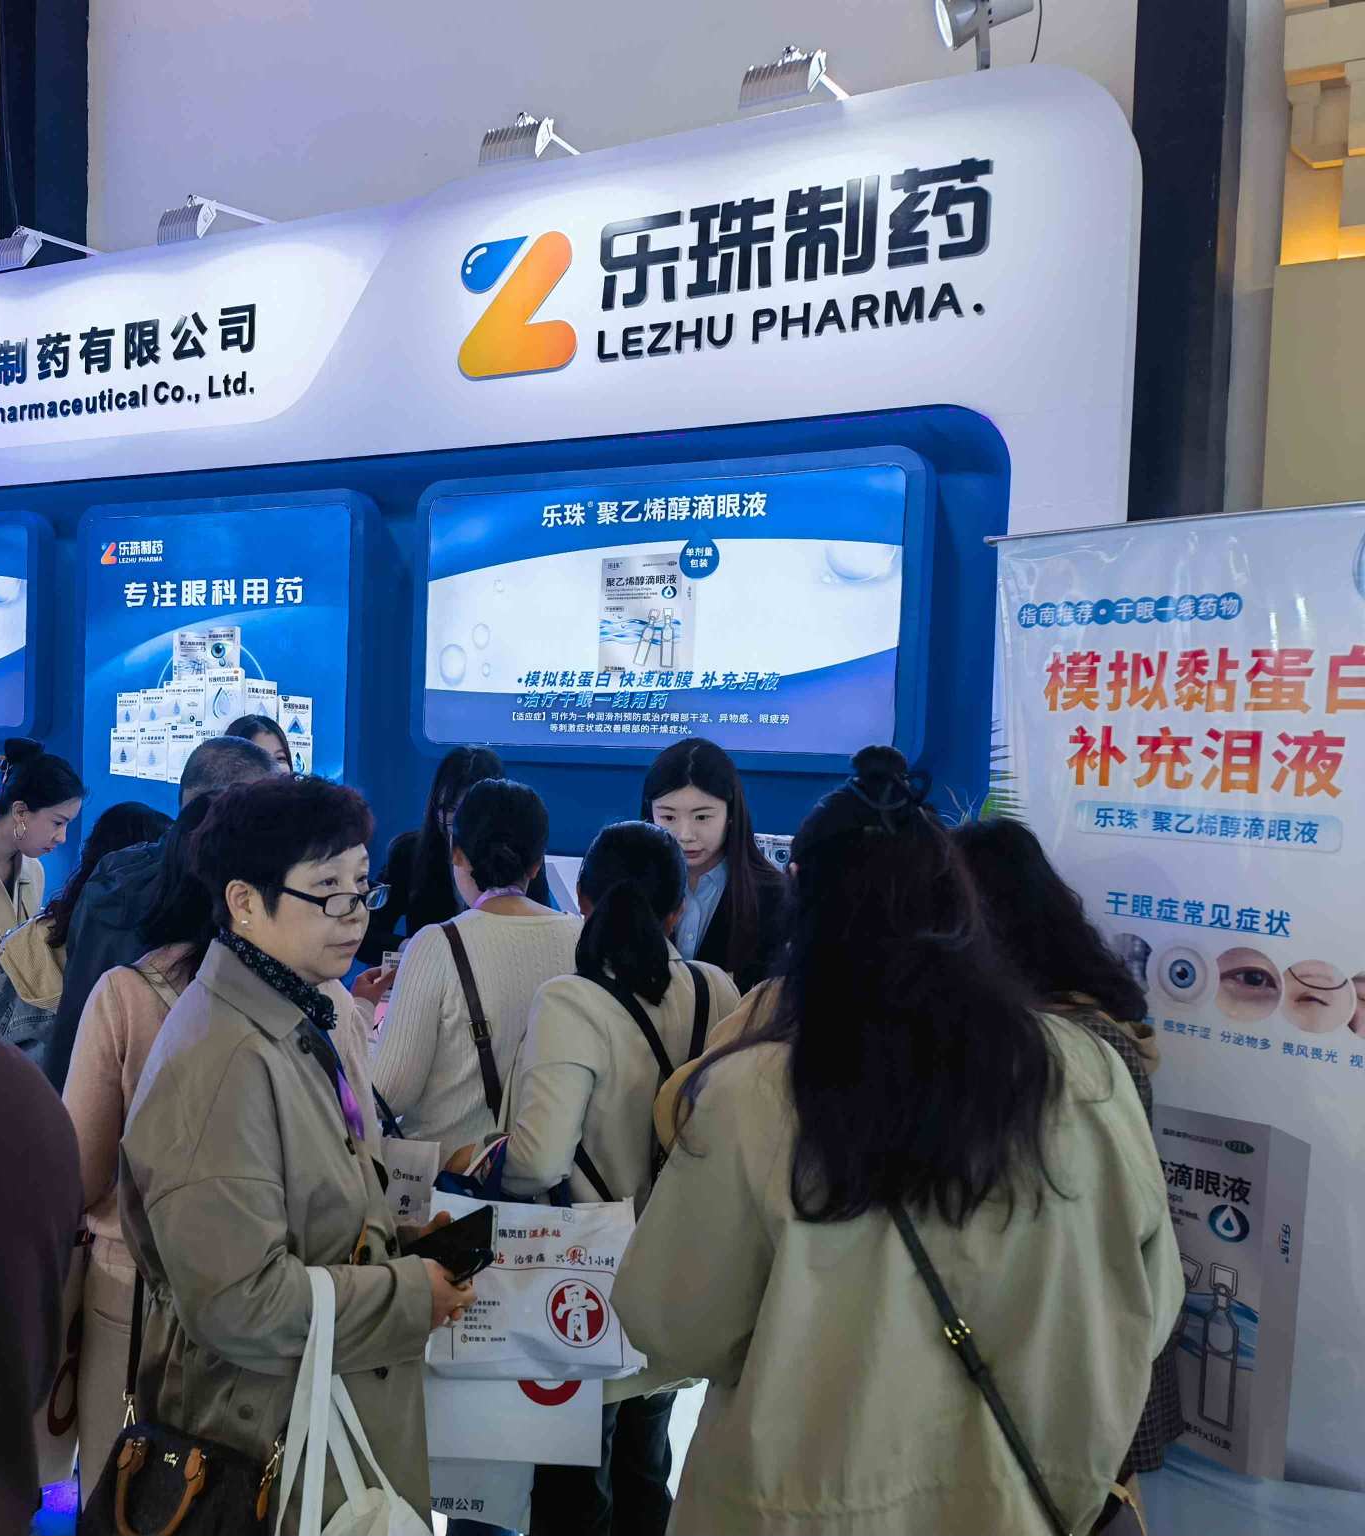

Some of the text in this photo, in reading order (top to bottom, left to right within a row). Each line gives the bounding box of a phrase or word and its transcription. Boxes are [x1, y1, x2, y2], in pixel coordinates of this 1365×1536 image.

[599, 157, 997, 313] 乐珠制药
[596, 311, 735, 363] LEZHU
[153, 379, 201, 405] Co.,
[207, 371, 255, 400] Ltd.
[118, 540, 164, 556] 乐珠制药
[685, 547, 713, 558] 单剂量
[689, 558, 709, 569] 包装
[123, 576, 305, 609] 专注眼科用药
[606, 574, 678, 588] 聚乙烯醇滴眼液
[523, 670, 781, 691] 模拟黏蛋白 快速成膜 补充泪液
[1043, 646, 1365, 715] 模拟黏蛋白
[523, 690, 670, 709] 治疗干眼一线用药
[1066, 724, 1347, 799] 补充泪液
[1105, 890, 1292, 936] 干眼症常见症状
[1220, 1030, 1272, 1050] 分泌物多
[1281, 1041, 1339, 1064] 畏风畏光
[555, 1284, 600, 1343] 骨
